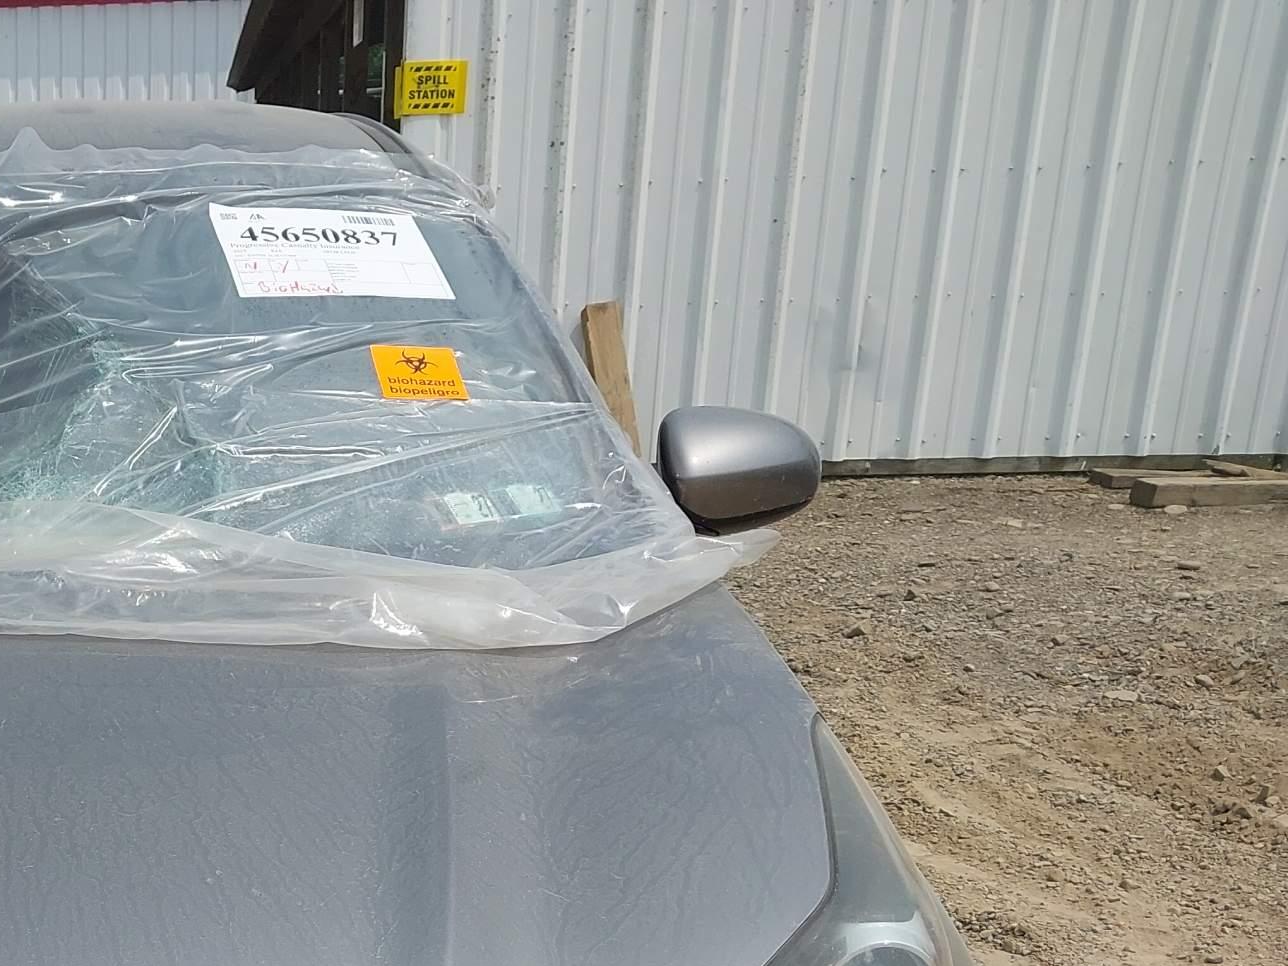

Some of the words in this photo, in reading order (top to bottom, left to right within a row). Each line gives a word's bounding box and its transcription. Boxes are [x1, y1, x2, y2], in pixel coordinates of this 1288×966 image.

[417, 75, 449, 85] SPILL
[408, 89, 456, 100] STATION
[240, 226, 397, 246] 45650837
[387, 376, 456, 387] biohazard
[389, 386, 460, 397] biopeligro
